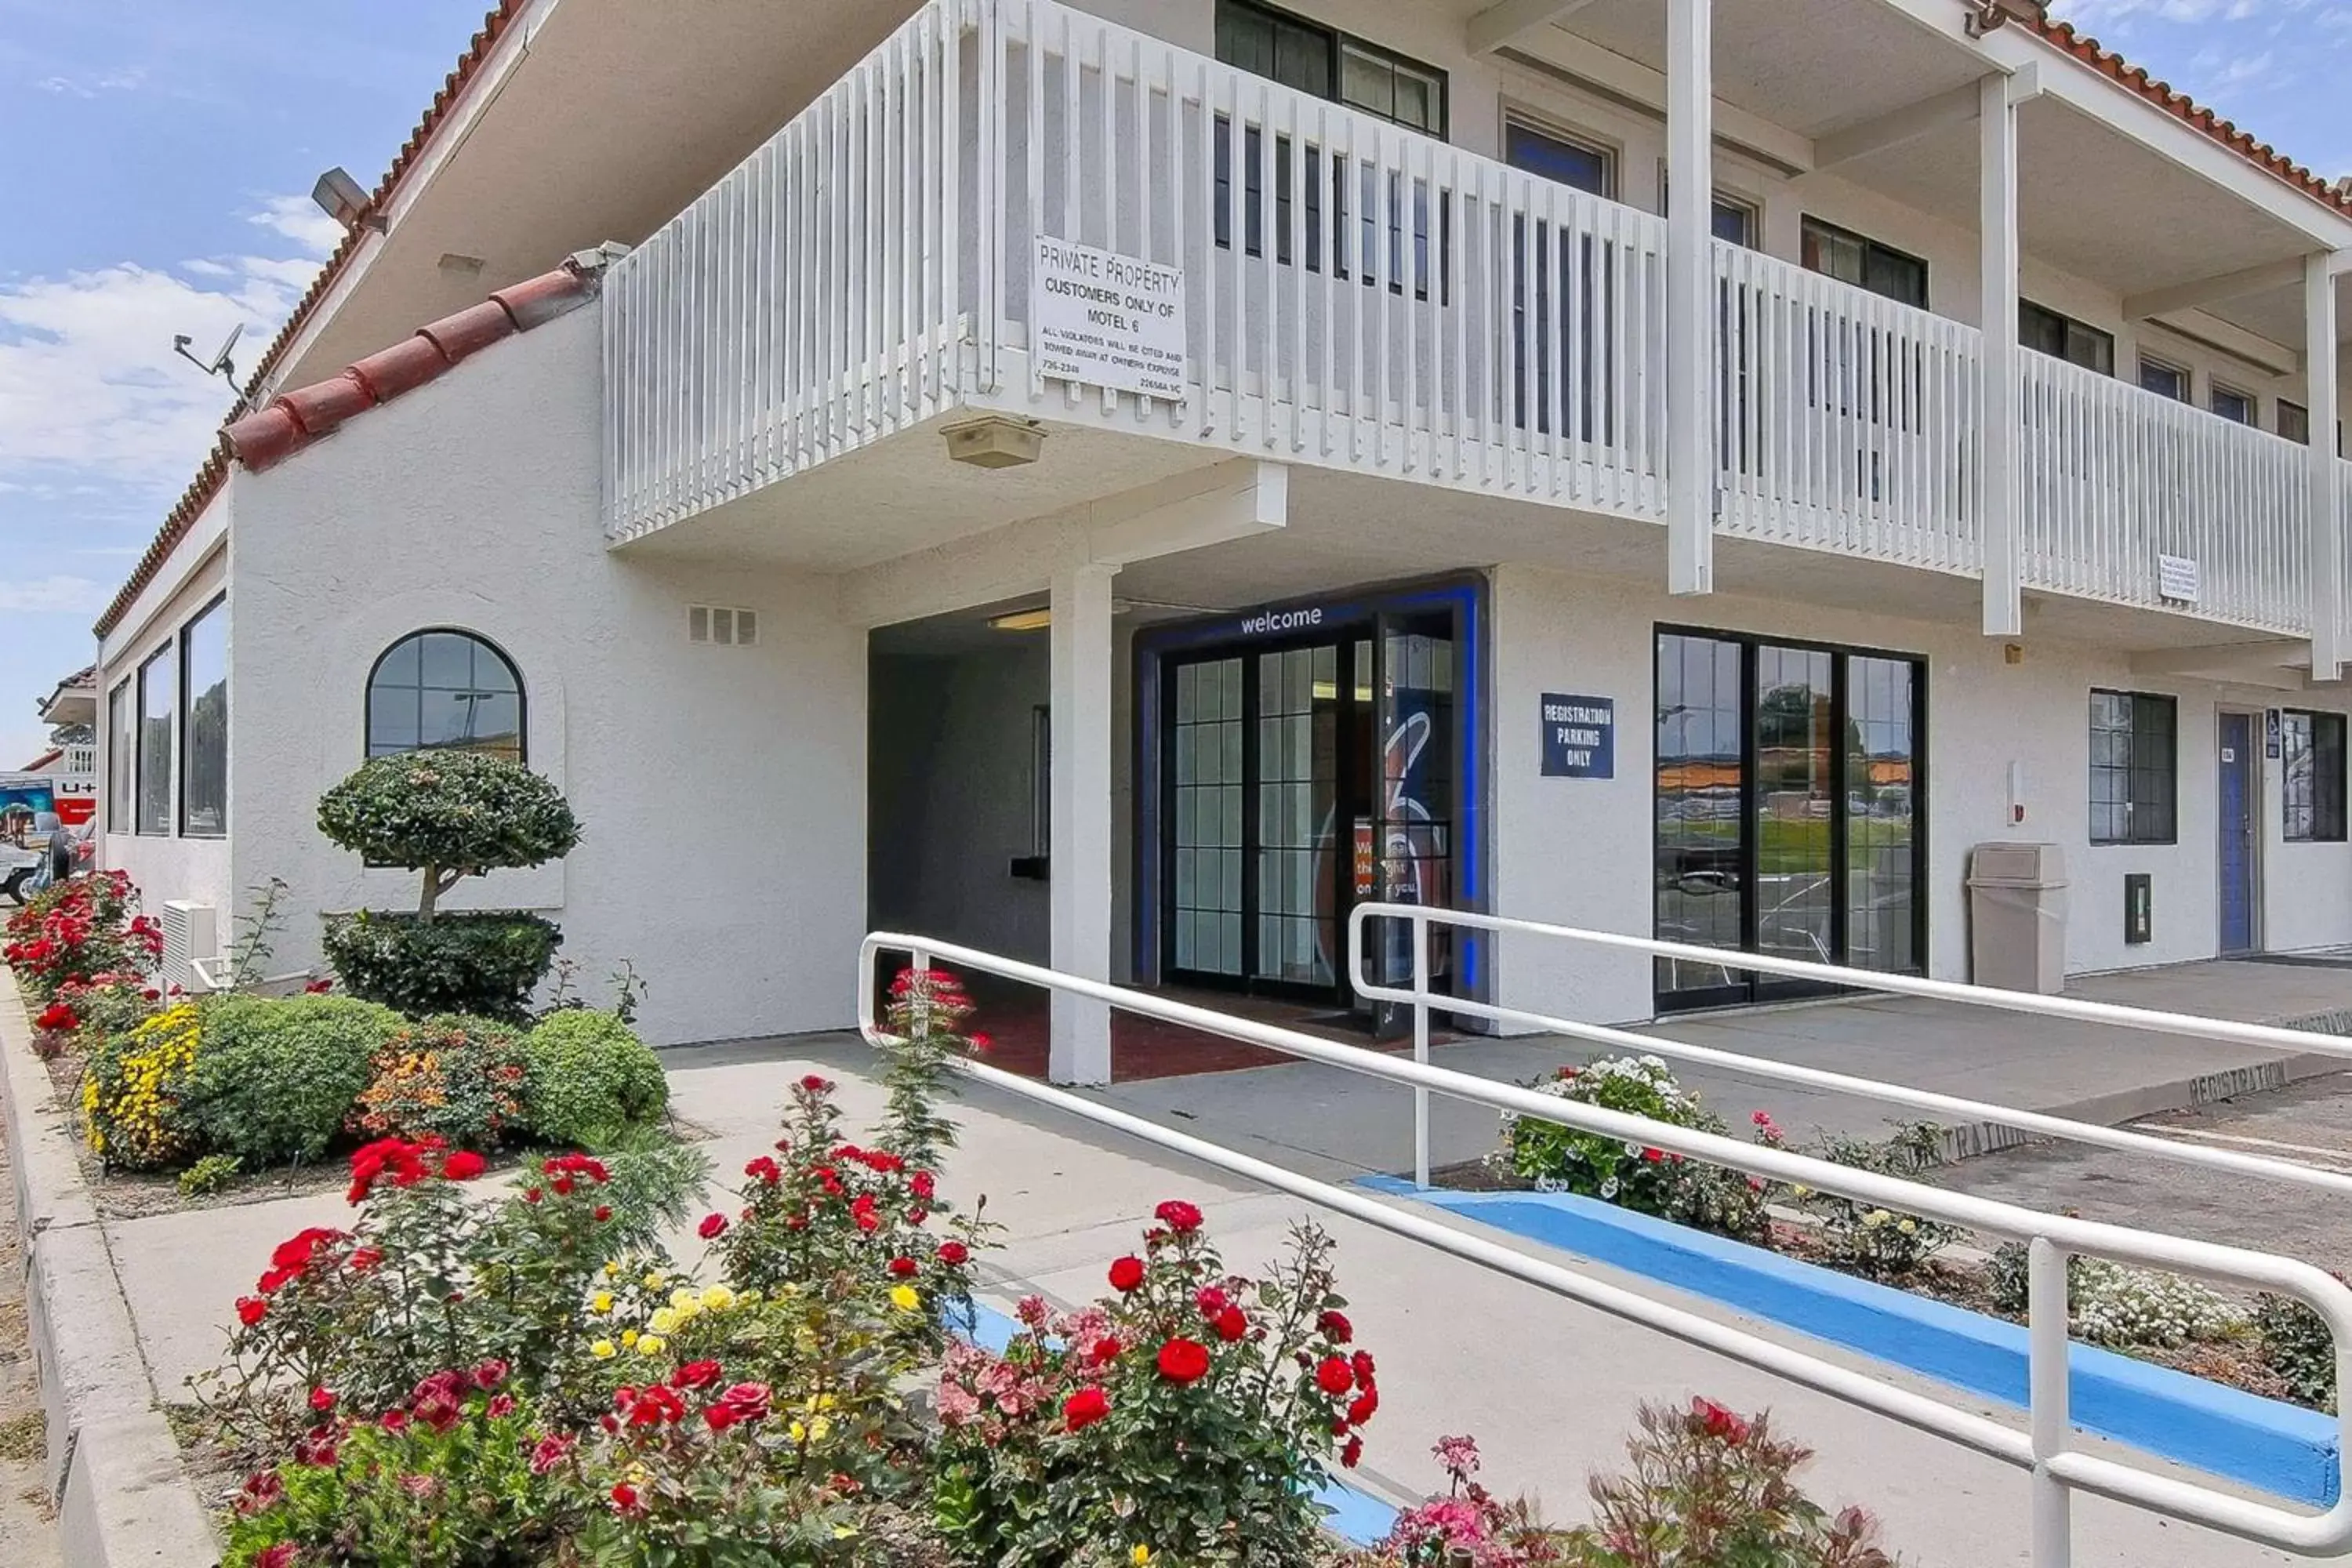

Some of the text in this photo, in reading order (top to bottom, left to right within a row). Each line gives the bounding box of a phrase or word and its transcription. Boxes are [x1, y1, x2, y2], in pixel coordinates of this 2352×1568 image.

[1040, 244, 1179, 296] PRIVATE PROPERTY
[1045, 277, 1175, 318] CUSTOMERS ONLY OF
[1087, 309, 1140, 333] MOTEL 6
[1041, 325, 1058, 338] ALL
[1059, 328, 1105, 347] VIOLATORS
[1107, 339, 1125, 351] WILL
[1241, 608, 1323, 634] welcome
[1544, 704, 1612, 725] REGISTRATION
[1557, 726, 1601, 747] PARKING
[1567, 749, 1592, 768] ONLY
